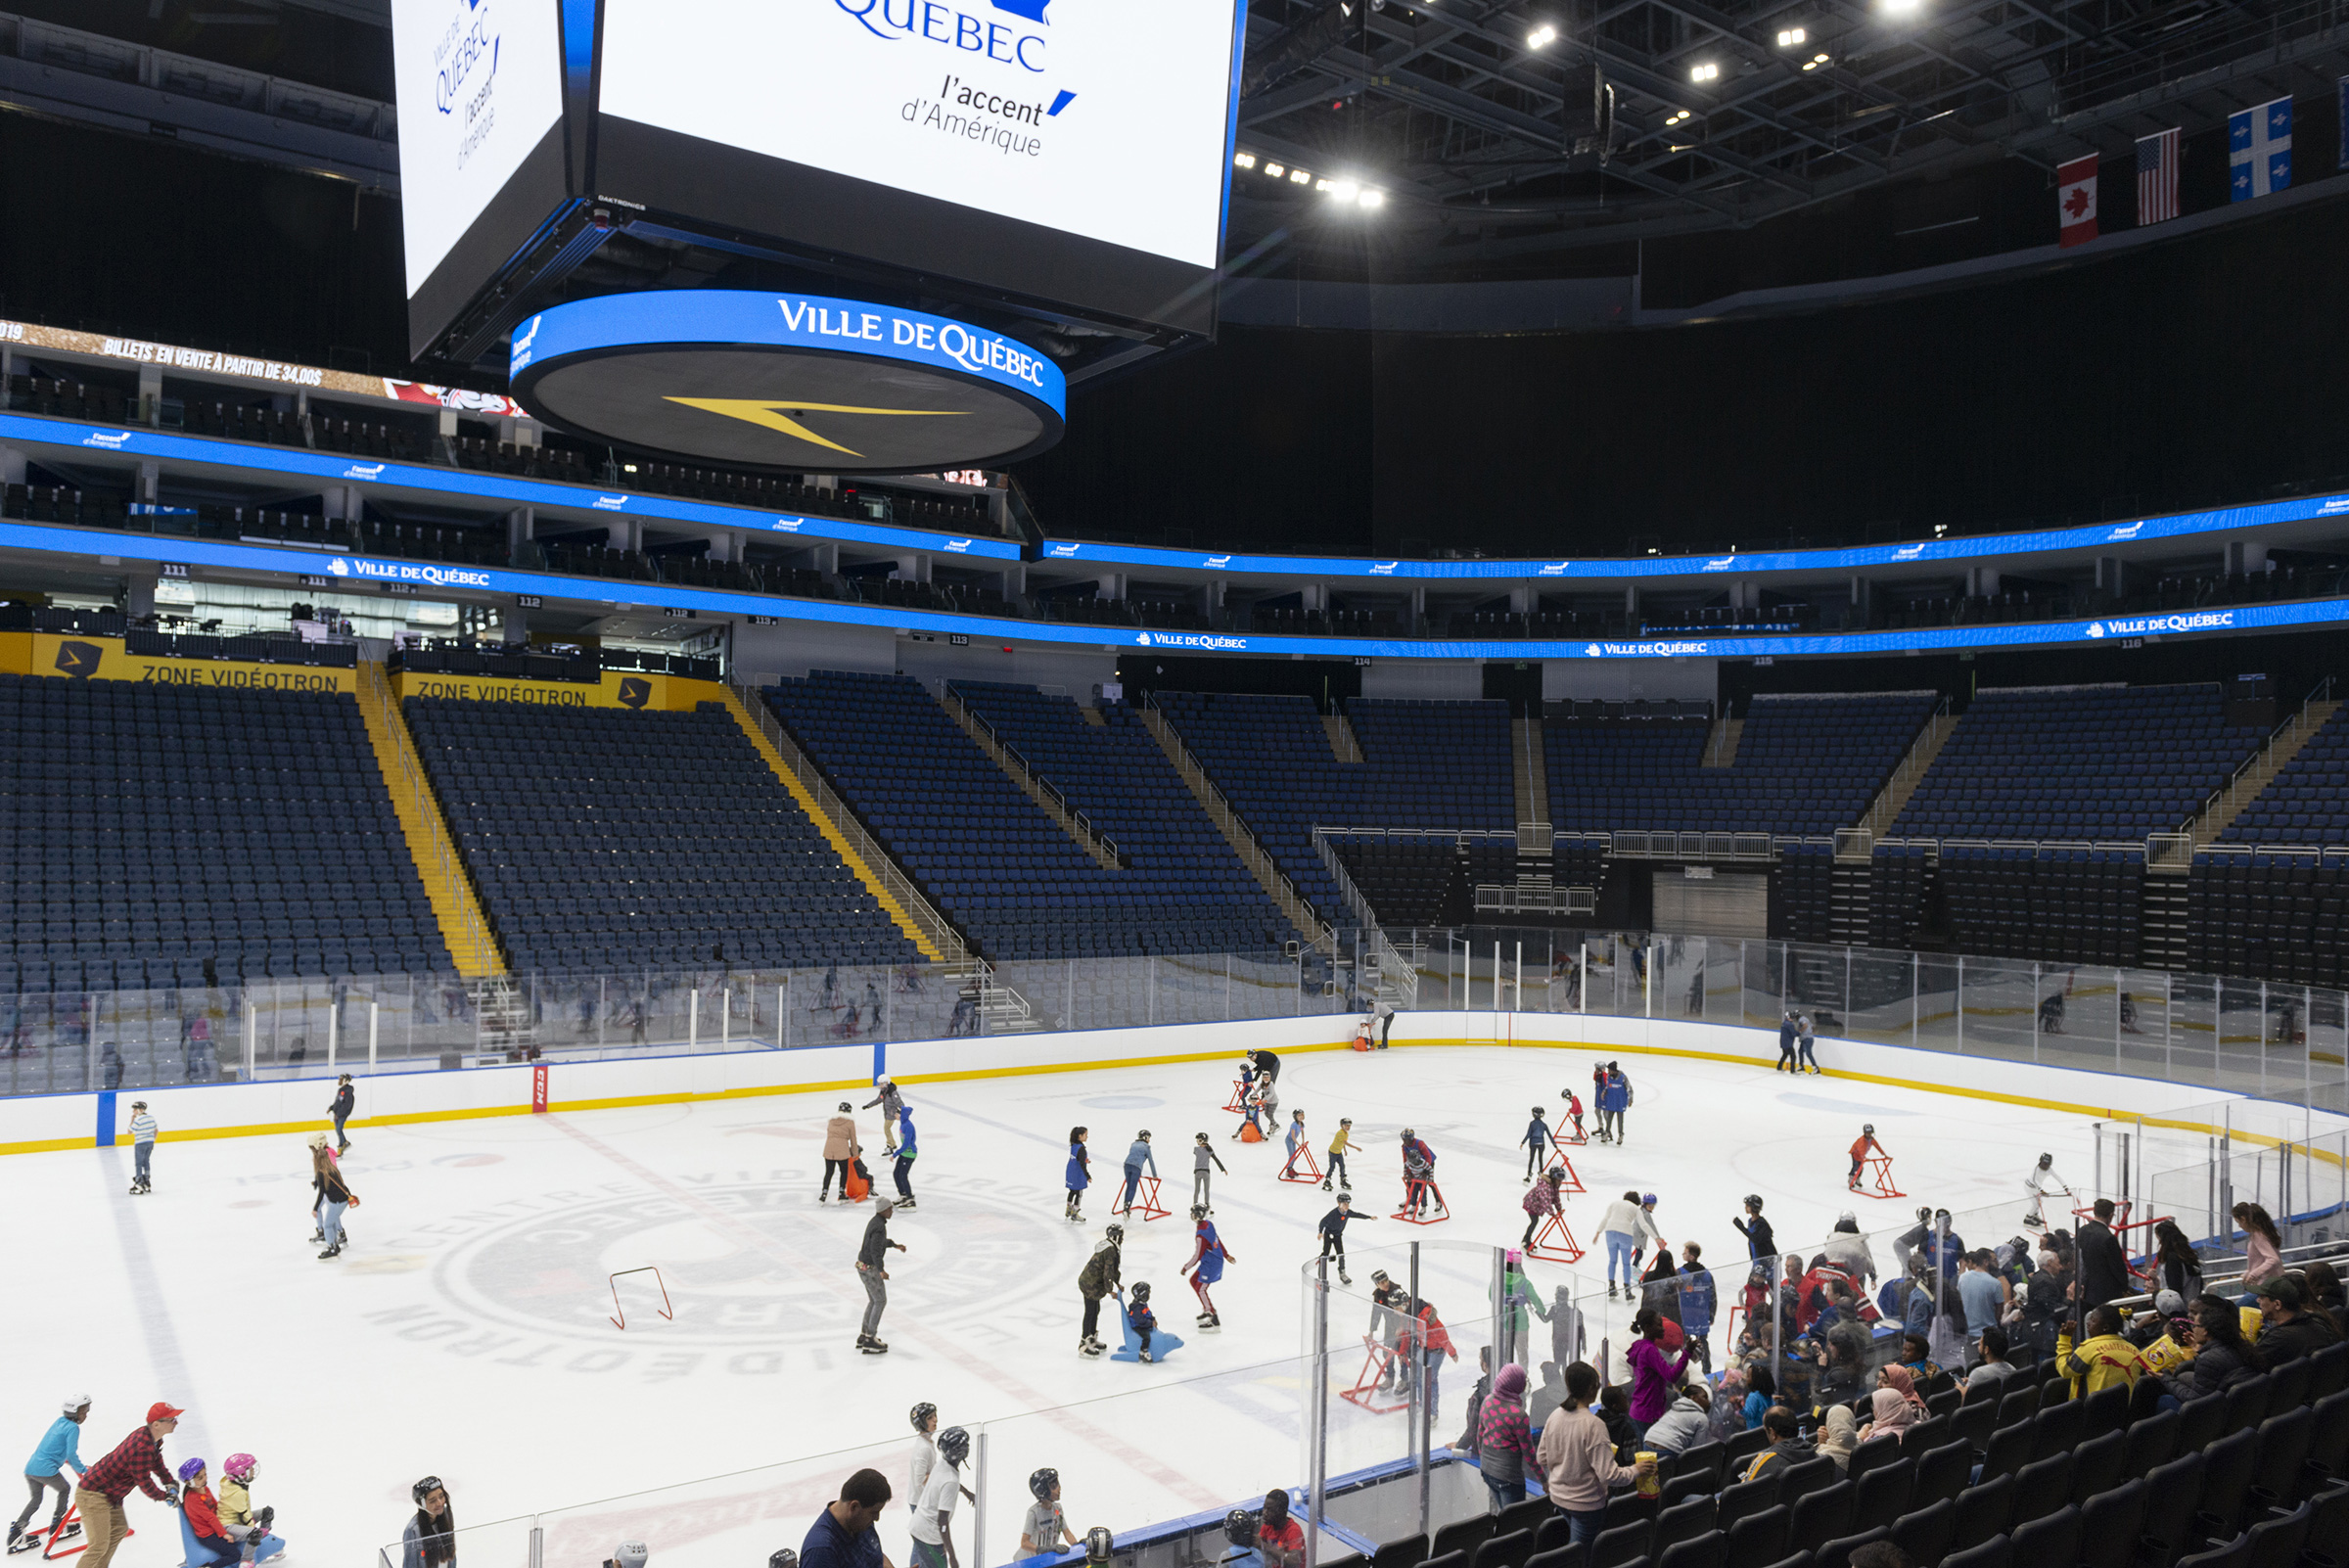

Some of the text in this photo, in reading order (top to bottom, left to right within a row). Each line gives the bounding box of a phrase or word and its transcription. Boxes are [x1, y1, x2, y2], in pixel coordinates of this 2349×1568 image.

[437, 6, 490, 115] QUÉBEC
[941, 73, 1044, 127] l'accent
[901, 98, 1042, 157] d'Amérique
[598, 195, 646, 211] DAKTRONICS
[777, 299, 1044, 388] VILLE DE QUÉBEC
[104, 339, 323, 387] BILLETS EN VENTE À PARTIR DE 34,00$
[163, 564, 187, 577] 111
[354, 560, 490, 586] VILLE DE QUÉBEC
[519, 596, 541, 608] 112
[2108, 613, 2234, 633] VILLE DE QUÉBEC
[951, 635, 968, 645] 113
[1154, 633, 1247, 650] VILLE DE QUÉBEC
[1604, 641, 1708, 657] VILLE DE QUÉBEC
[1355, 657, 1371, 666] 114
[143, 665, 338, 692] ZONE VIDÉOTRON
[418, 681, 586, 707] ZONE VIDÉOTRON
[536, 1069, 545, 1105] CCM
[384, 1168, 1066, 1251] CENTRE VIDOTRON
